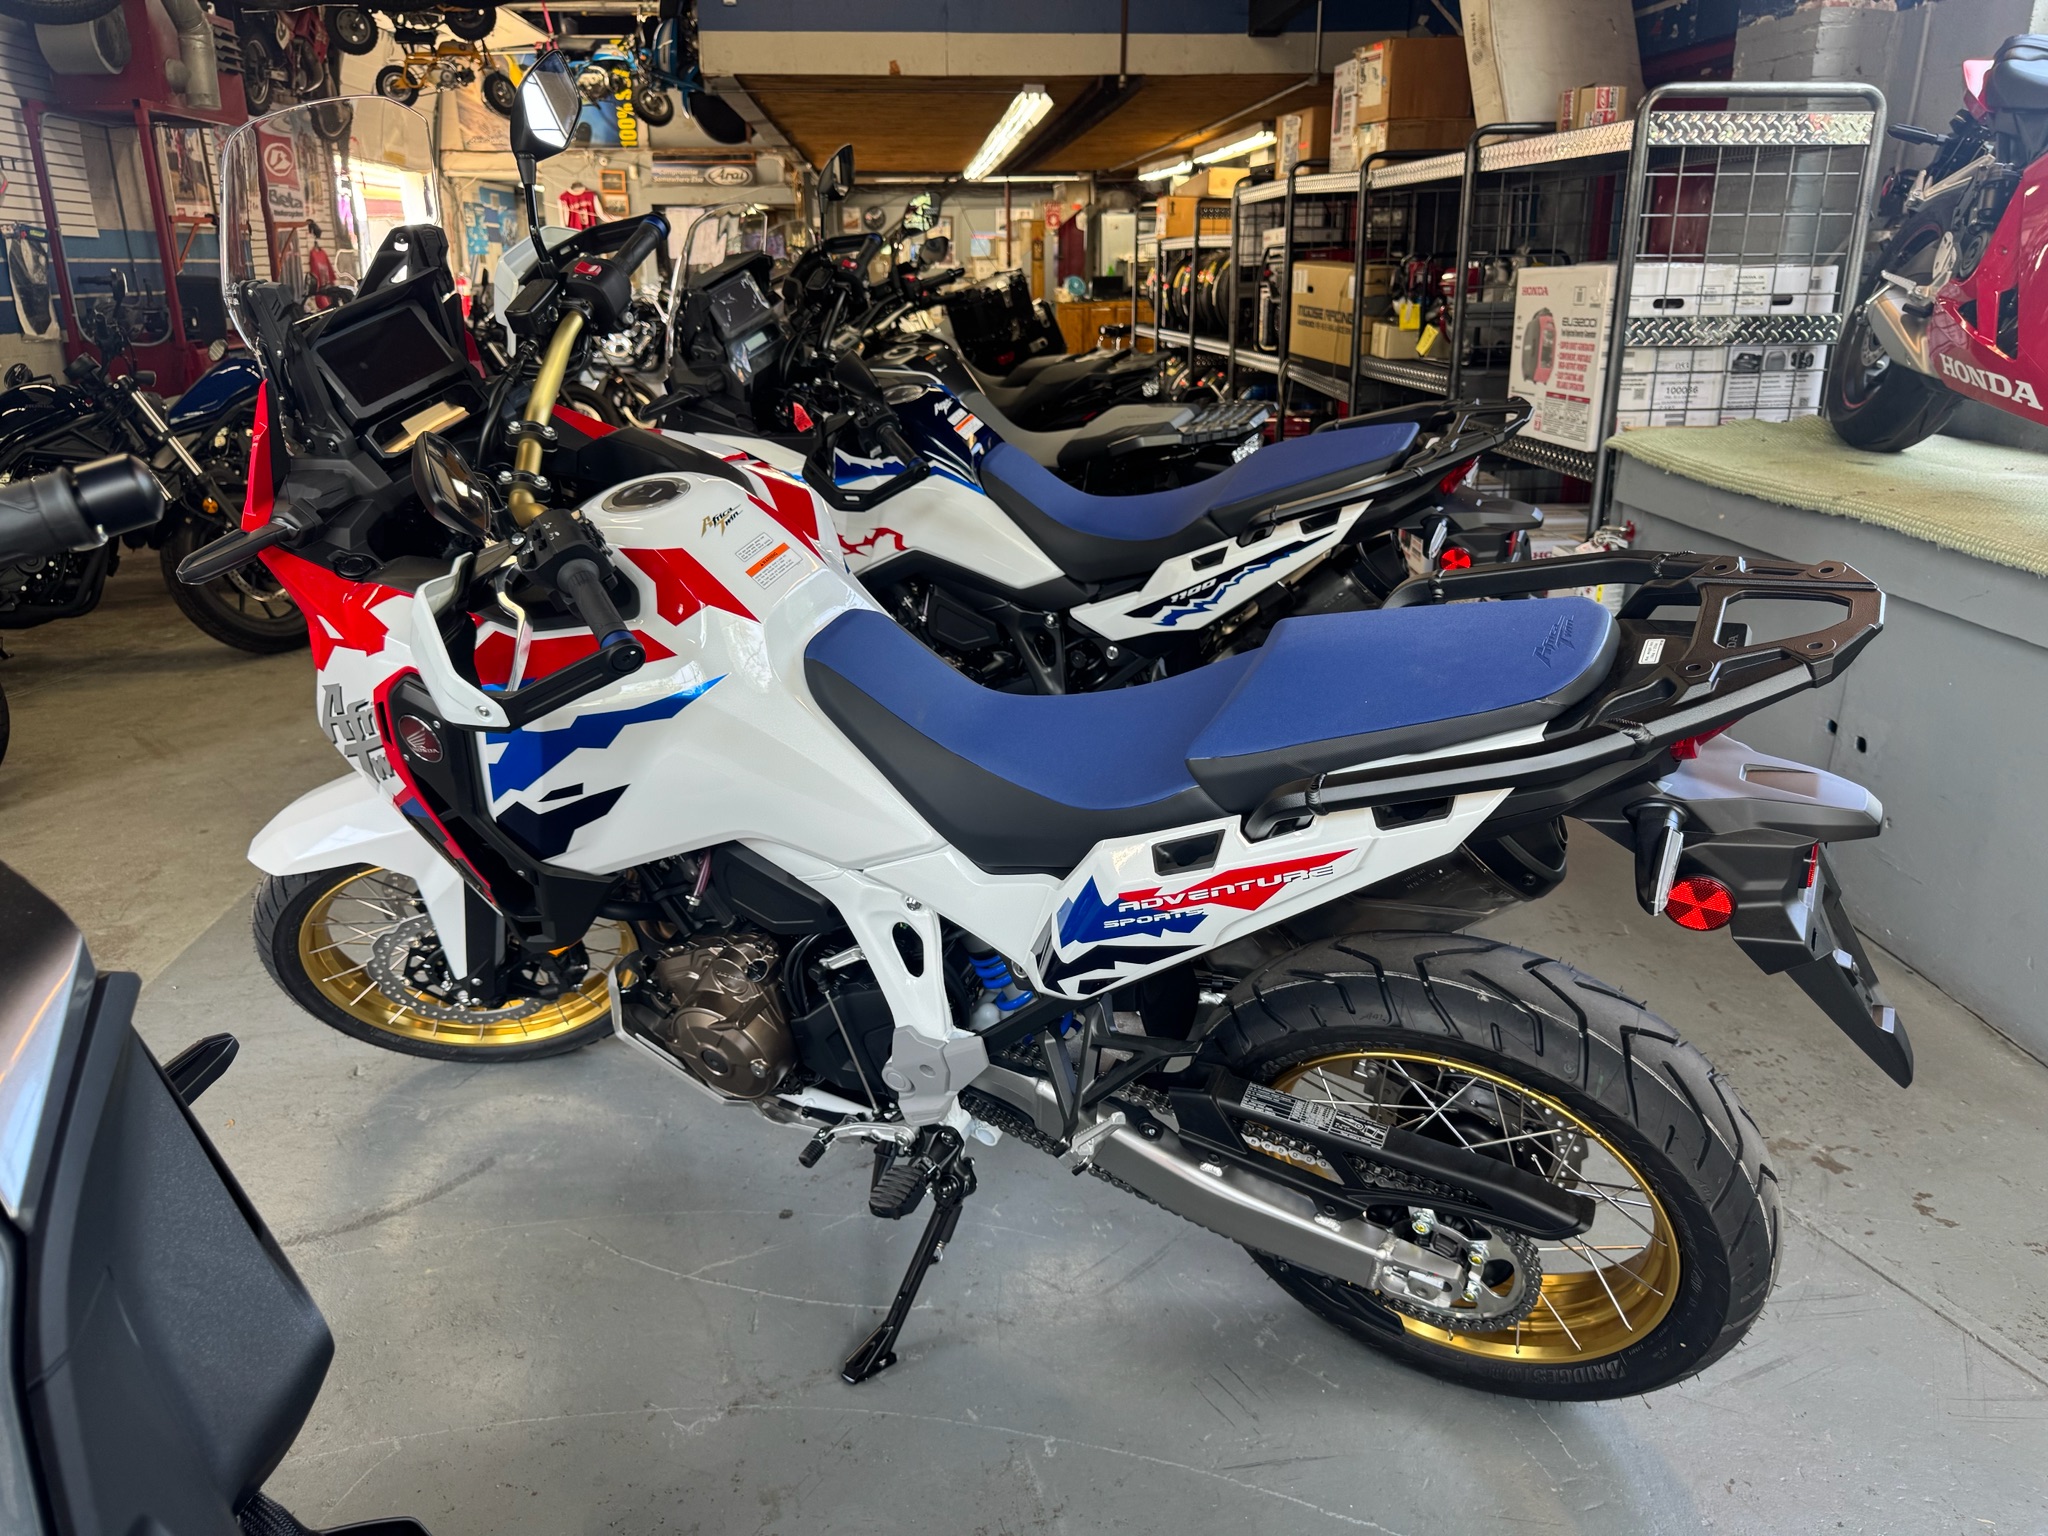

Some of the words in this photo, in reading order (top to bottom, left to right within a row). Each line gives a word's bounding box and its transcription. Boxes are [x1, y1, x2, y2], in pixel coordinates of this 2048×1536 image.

[710, 166, 745, 181] Arai
[269, 189, 303, 208] Beta
[1522, 286, 1549, 296] HONDA
[1939, 353, 2044, 411] HONDA
[701, 504, 741, 538] Africa
[716, 510, 743, 537] Twin
[1170, 578, 1218, 603] 1100
[412, 746, 440, 754] HONDA
[1118, 865, 1334, 913] ADVENTURE
[1103, 908, 1204, 929] SPORTS
